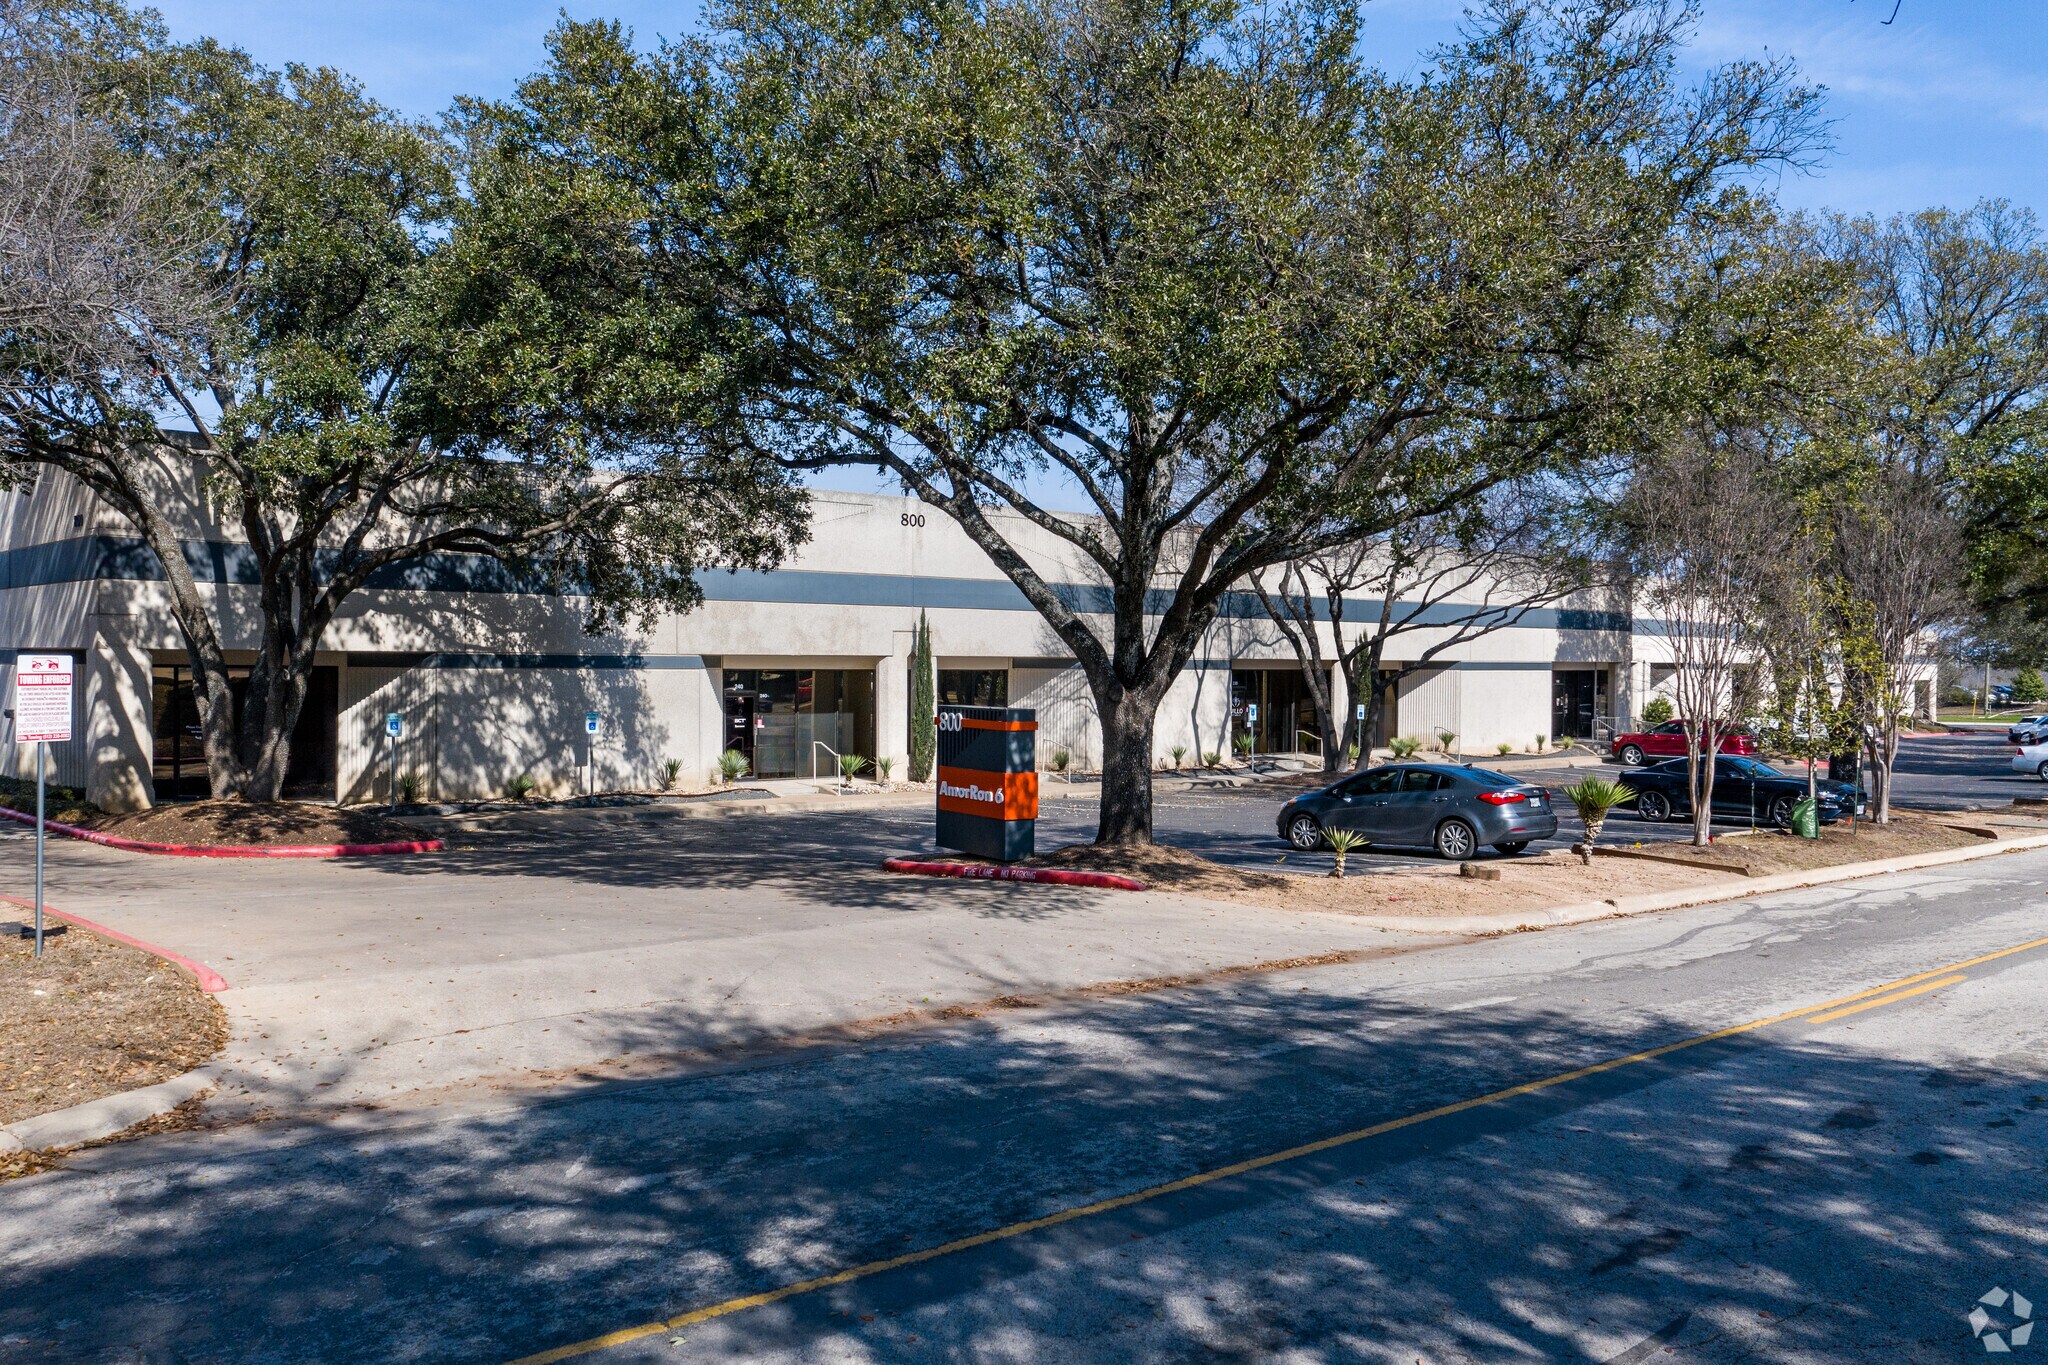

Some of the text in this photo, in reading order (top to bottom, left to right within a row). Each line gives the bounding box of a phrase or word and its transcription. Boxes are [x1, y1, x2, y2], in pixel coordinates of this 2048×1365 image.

[901, 513, 925, 527] 800
[20, 674, 42, 685] TOWING
[940, 712, 962, 731] 800
[995, 788, 1004, 804] 6
[979, 868, 994, 878] LANE
[1001, 869, 1009, 878] NO
[1012, 870, 1037, 880] PARKING
